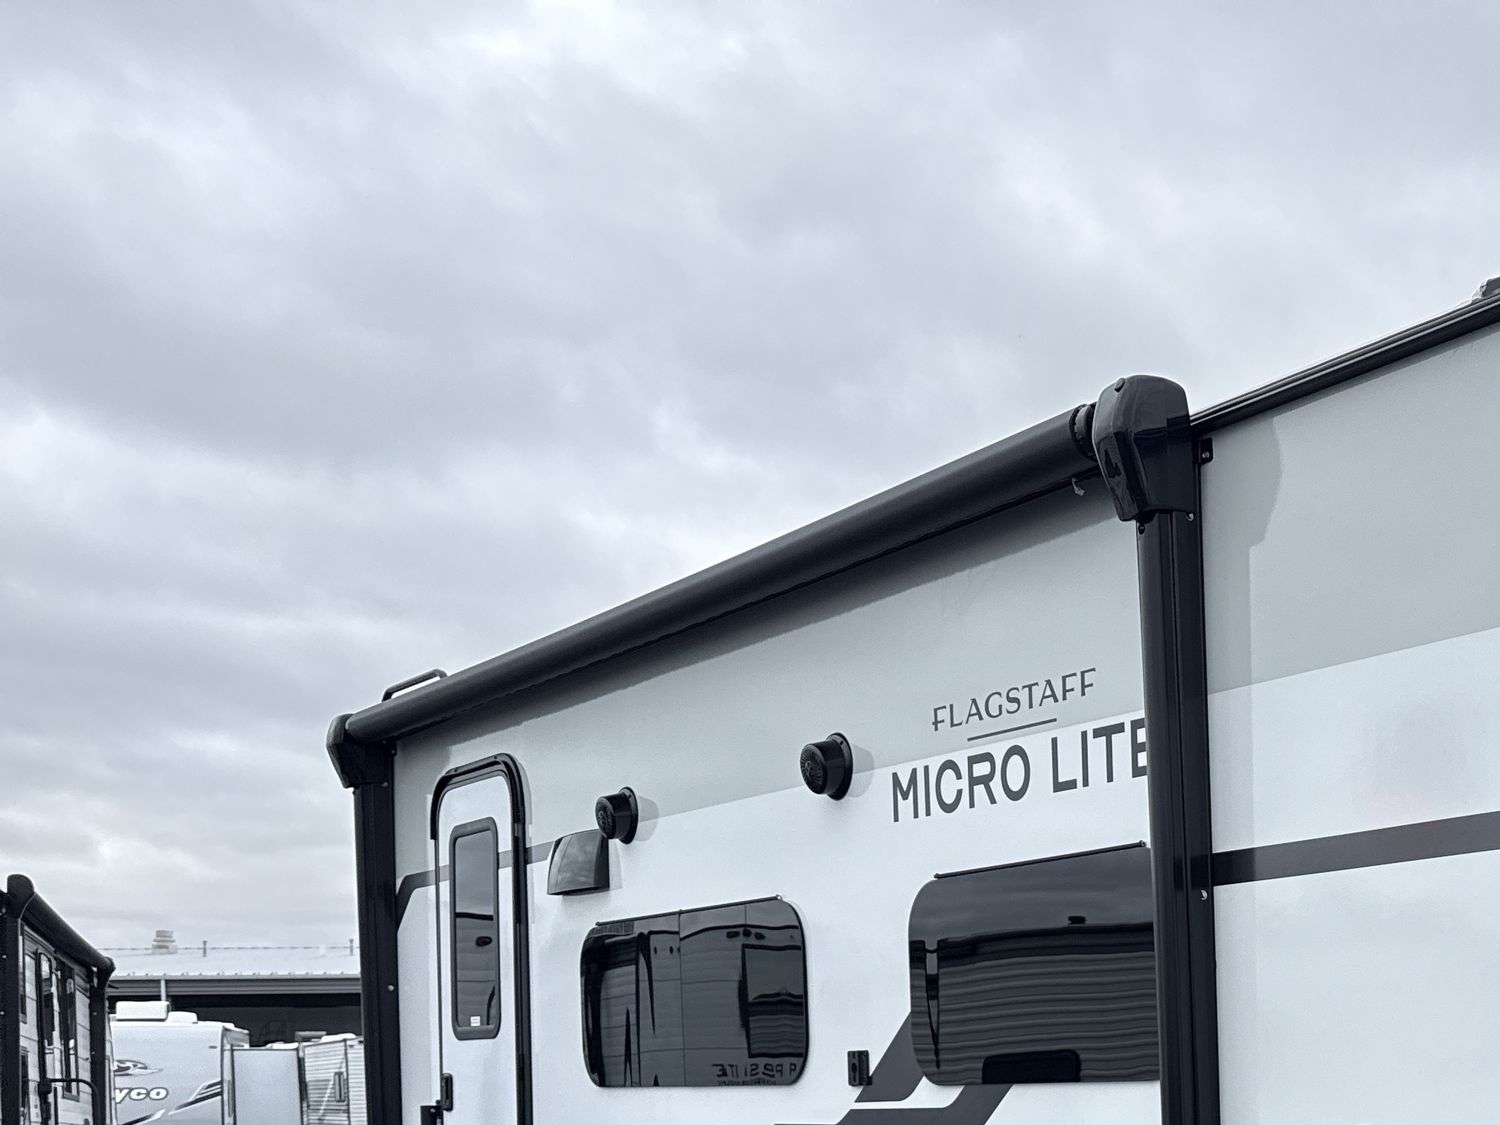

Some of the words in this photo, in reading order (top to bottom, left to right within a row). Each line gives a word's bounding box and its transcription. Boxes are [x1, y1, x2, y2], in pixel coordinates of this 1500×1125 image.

[932, 667, 1097, 732] FLAGSTAFF
[892, 743, 1031, 823] MICRO
[1050, 717, 1147, 794] LITE
[114, 1086, 169, 1104] yco
